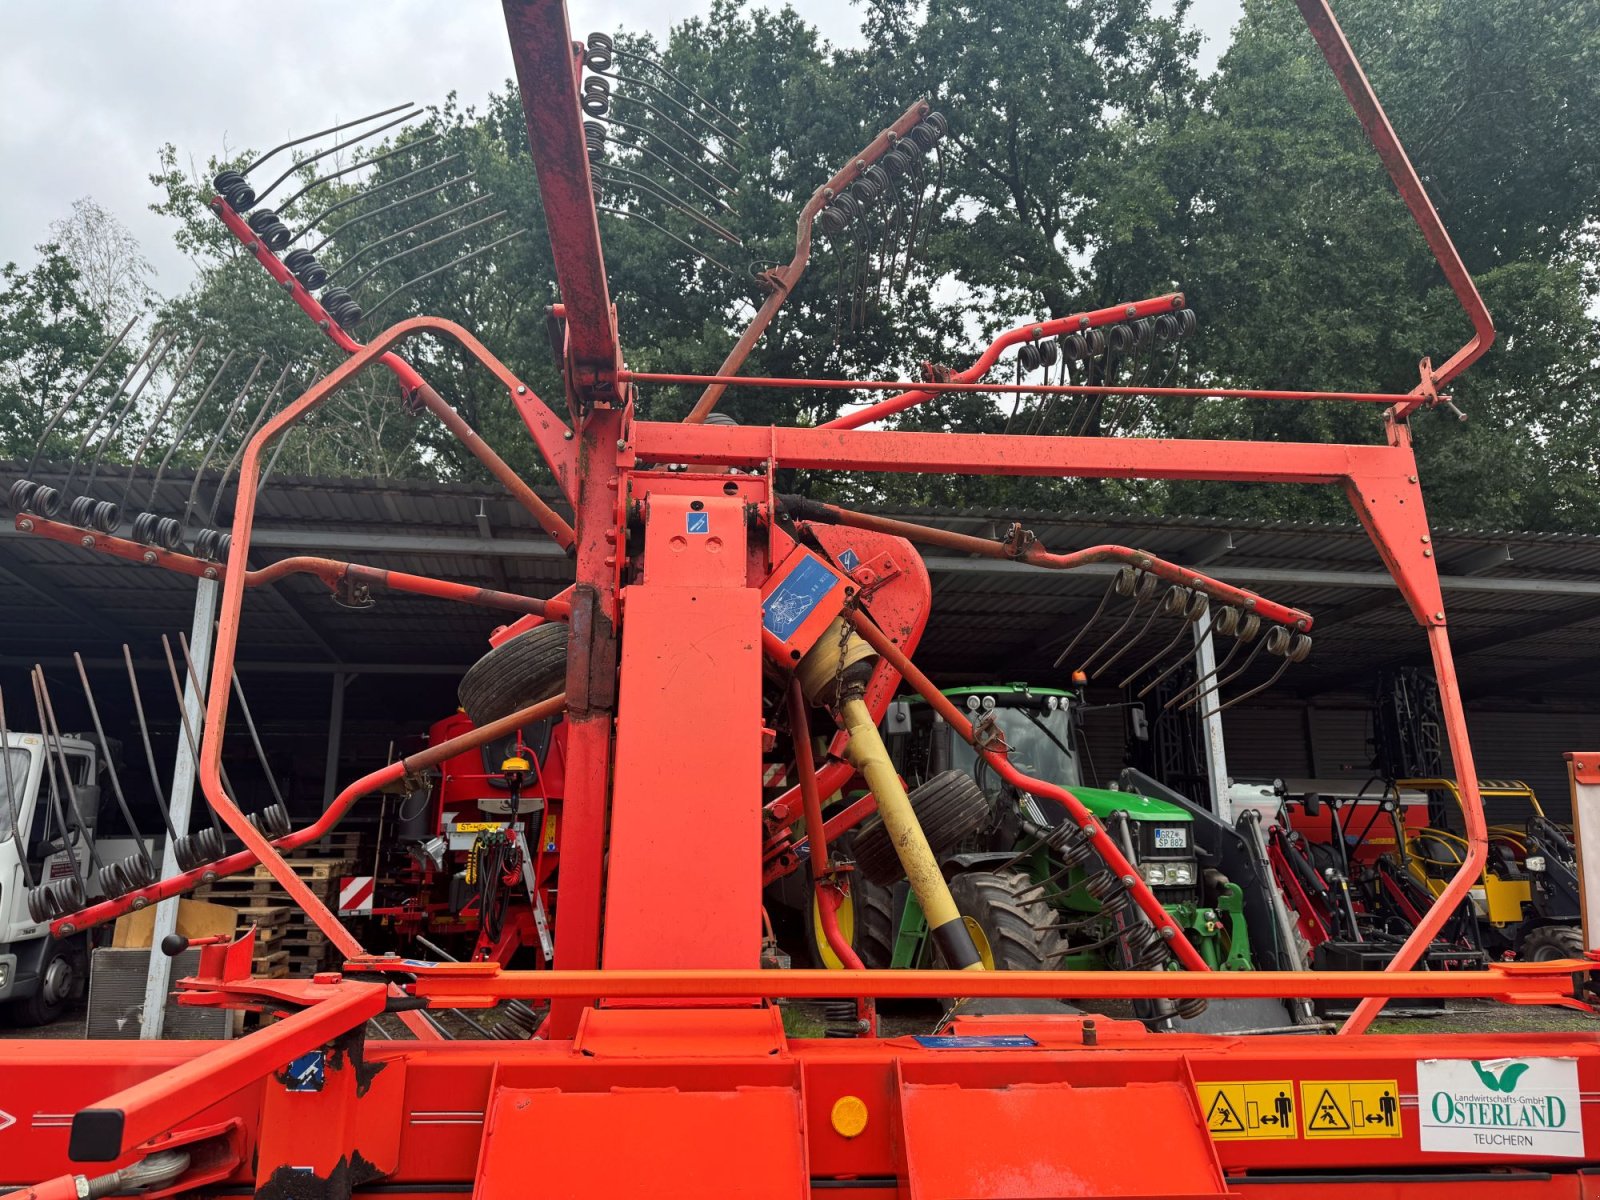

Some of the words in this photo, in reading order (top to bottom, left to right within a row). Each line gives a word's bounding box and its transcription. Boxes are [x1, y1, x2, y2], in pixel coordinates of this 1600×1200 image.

[1160, 830, 1175, 839] GRZ
[1158, 838, 1169, 847] SP
[1170, 838, 1184, 847] 882
[1454, 1093, 1545, 1105] Landwirtschafts-GmbH
[1431, 1091, 1566, 1128] OSTERLAND
[1473, 1133, 1533, 1147] TEUCHERN
